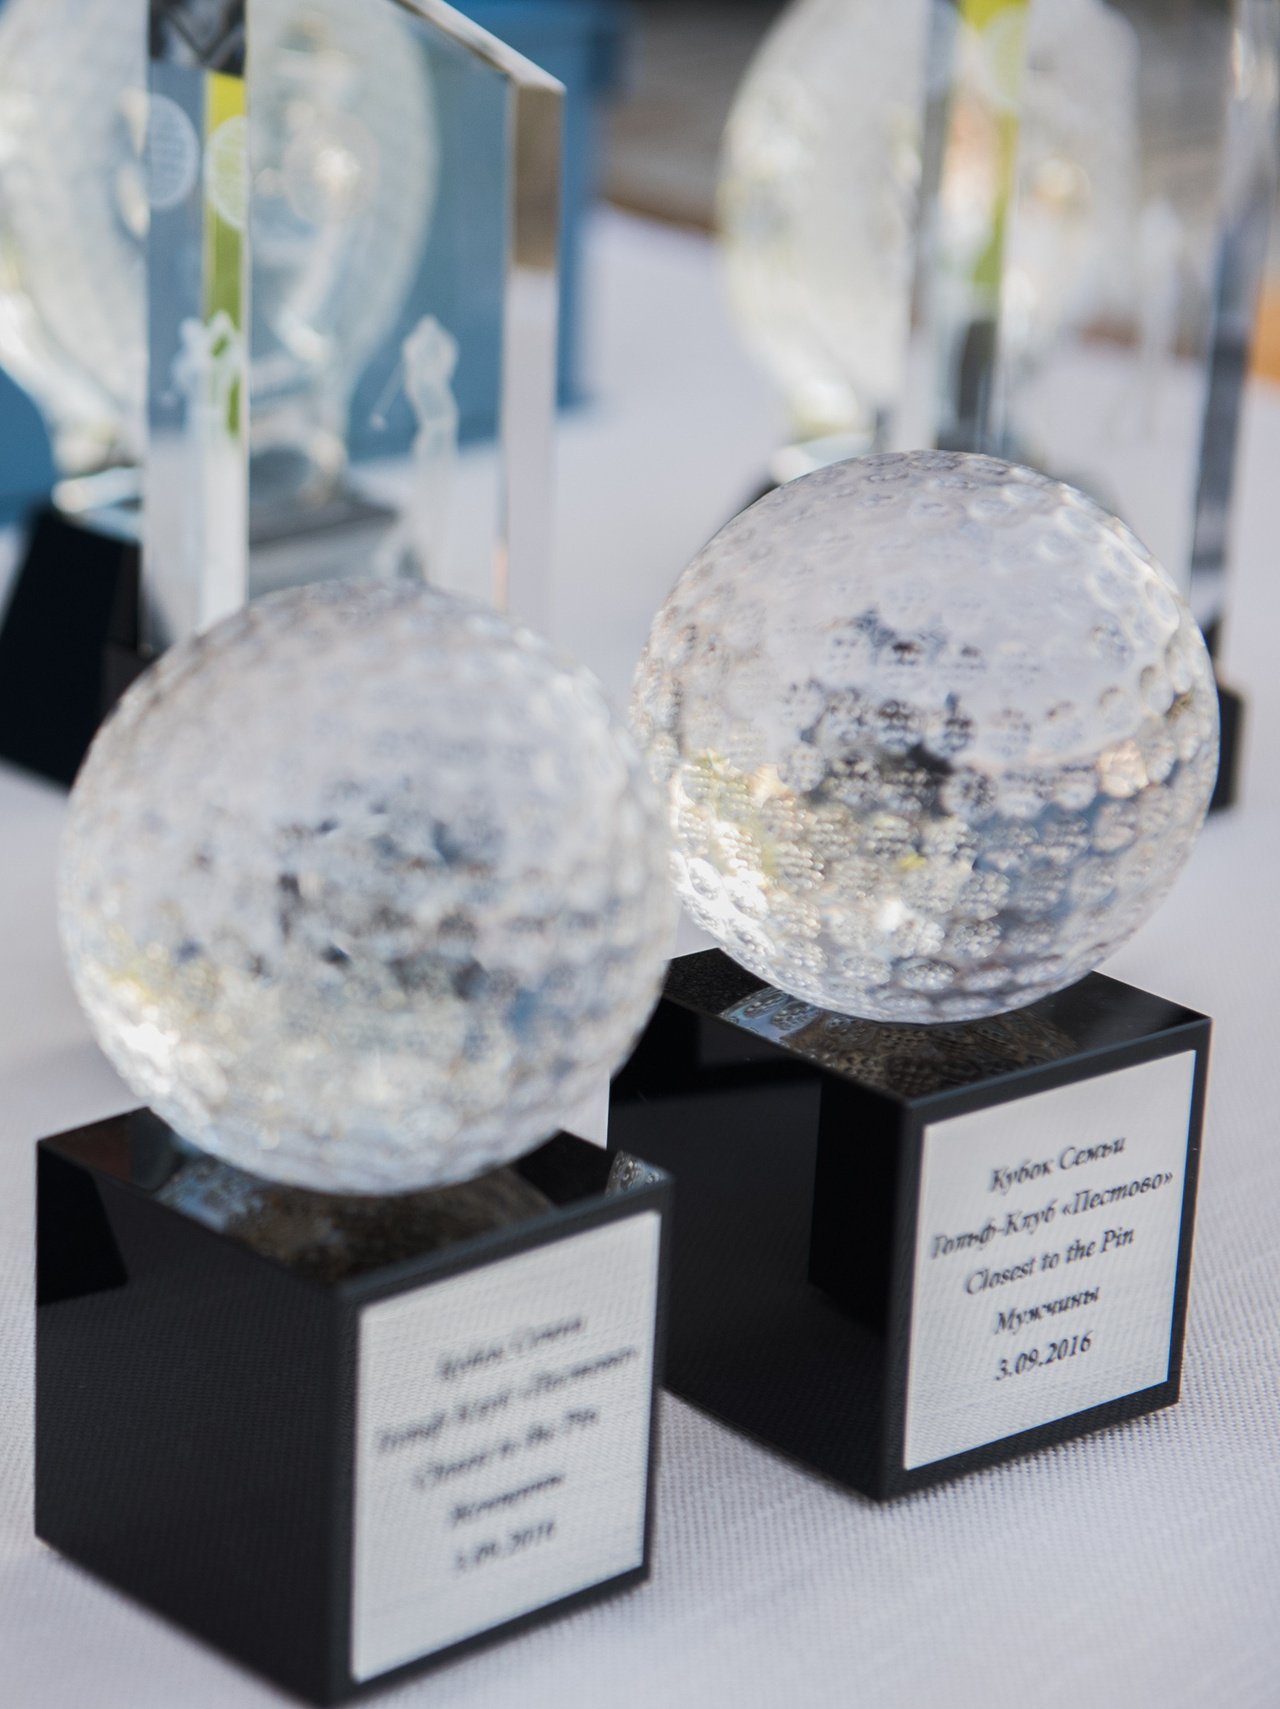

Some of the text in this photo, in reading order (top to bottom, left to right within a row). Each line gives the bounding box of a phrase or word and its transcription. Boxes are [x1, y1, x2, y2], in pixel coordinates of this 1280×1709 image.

[990, 1135, 1127, 1196] Кубок Семьи
[930, 1170, 1174, 1260] Гольф-Клуб «Пестово»
[965, 1226, 1135, 1295] Closest to the Pin
[994, 1286, 1100, 1337] Мужчины
[995, 1330, 1093, 1382] 3.09.2016
